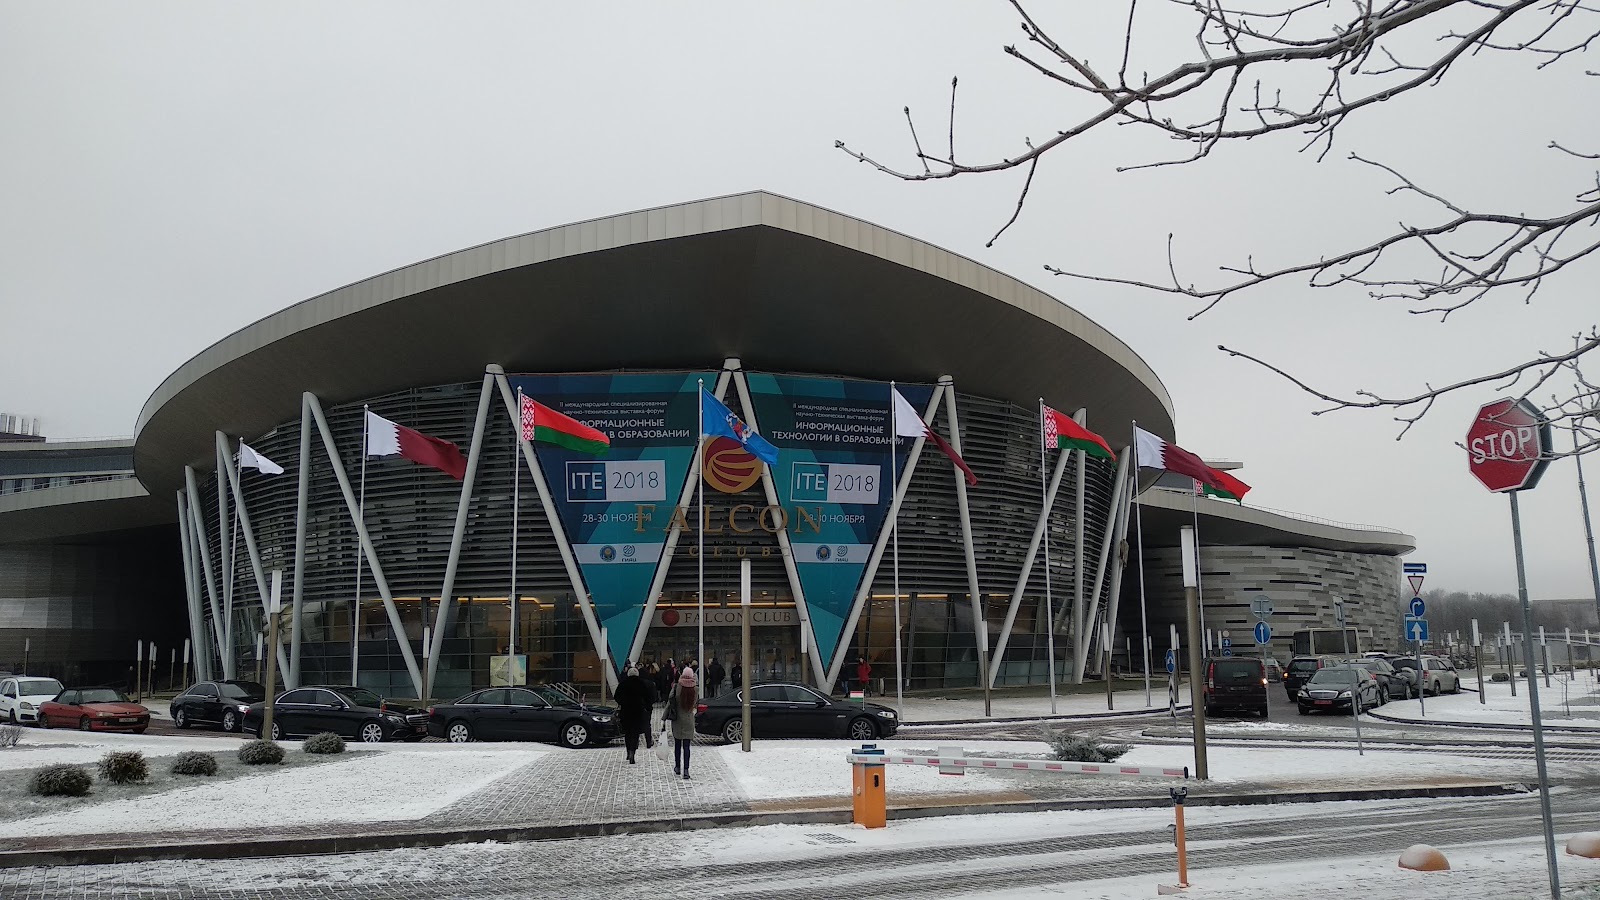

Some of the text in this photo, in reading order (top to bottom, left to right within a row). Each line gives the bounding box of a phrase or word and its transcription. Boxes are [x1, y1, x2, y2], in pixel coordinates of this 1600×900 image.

[565, 401, 609, 409] международная
[610, 400, 668, 408] специализированная
[797, 404, 838, 412] международная
[838, 406, 889, 414] специализированная
[795, 411, 885, 422] научно-техническая выставка-форум
[580, 419, 665, 428] ФОРМАЦИОННЫЕ
[795, 421, 884, 434] ИНФОРМАЦИОННЫЕ
[609, 431, 615, 439] В
[617, 429, 690, 439] ОБРАЗОВАНИИ
[771, 430, 833, 442] ТЕХНОЛОГИИ
[834, 434, 840, 443] В
[1471, 427, 1532, 464] STOP
[571, 471, 659, 490] ITE 2018
[796, 472, 874, 492] ITE 2018
[582, 513, 608, 523] 28-30
[633, 503, 824, 535] FALCON
[829, 514, 865, 524] НОЯБРЯ
[688, 546, 772, 557] CLUB
[753, 611, 791, 623] CLUB
